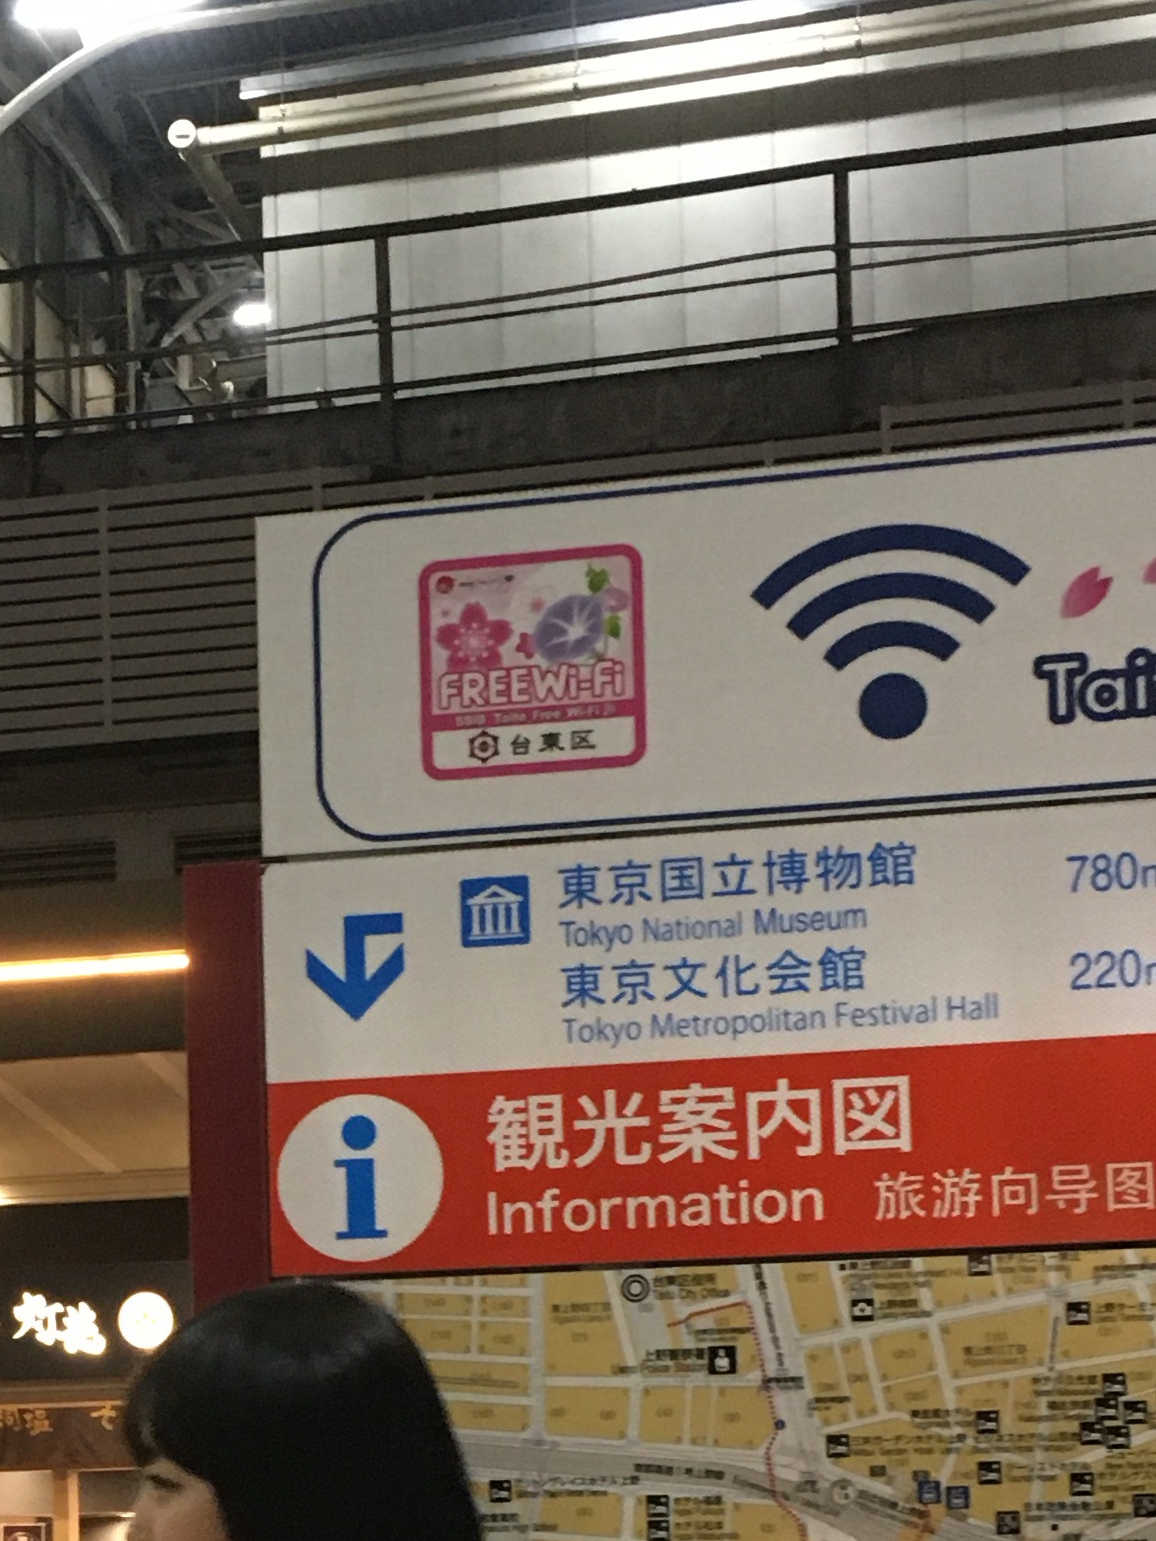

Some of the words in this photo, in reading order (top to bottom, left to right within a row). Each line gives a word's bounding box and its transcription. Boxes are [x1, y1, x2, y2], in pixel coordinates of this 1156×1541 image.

[1032, 647, 1156, 725] Tai
[510, 729, 596, 756] 台東区
[558, 841, 918, 910] 東京国立博物館
[559, 917, 634, 950] Tokyo
[643, 911, 742, 942] National
[754, 905, 868, 937] Museum
[560, 946, 867, 1008] 東京文化会館
[562, 1016, 643, 1049] Tokyo
[650, 1005, 828, 1045] Metropolitan
[834, 996, 938, 1032] Festival
[944, 992, 999, 1025] Hall
[486, 1075, 912, 1173] 観光案内図
[487, 1180, 825, 1235] Information
[873, 1160, 1156, 1222] 旅游向导图
